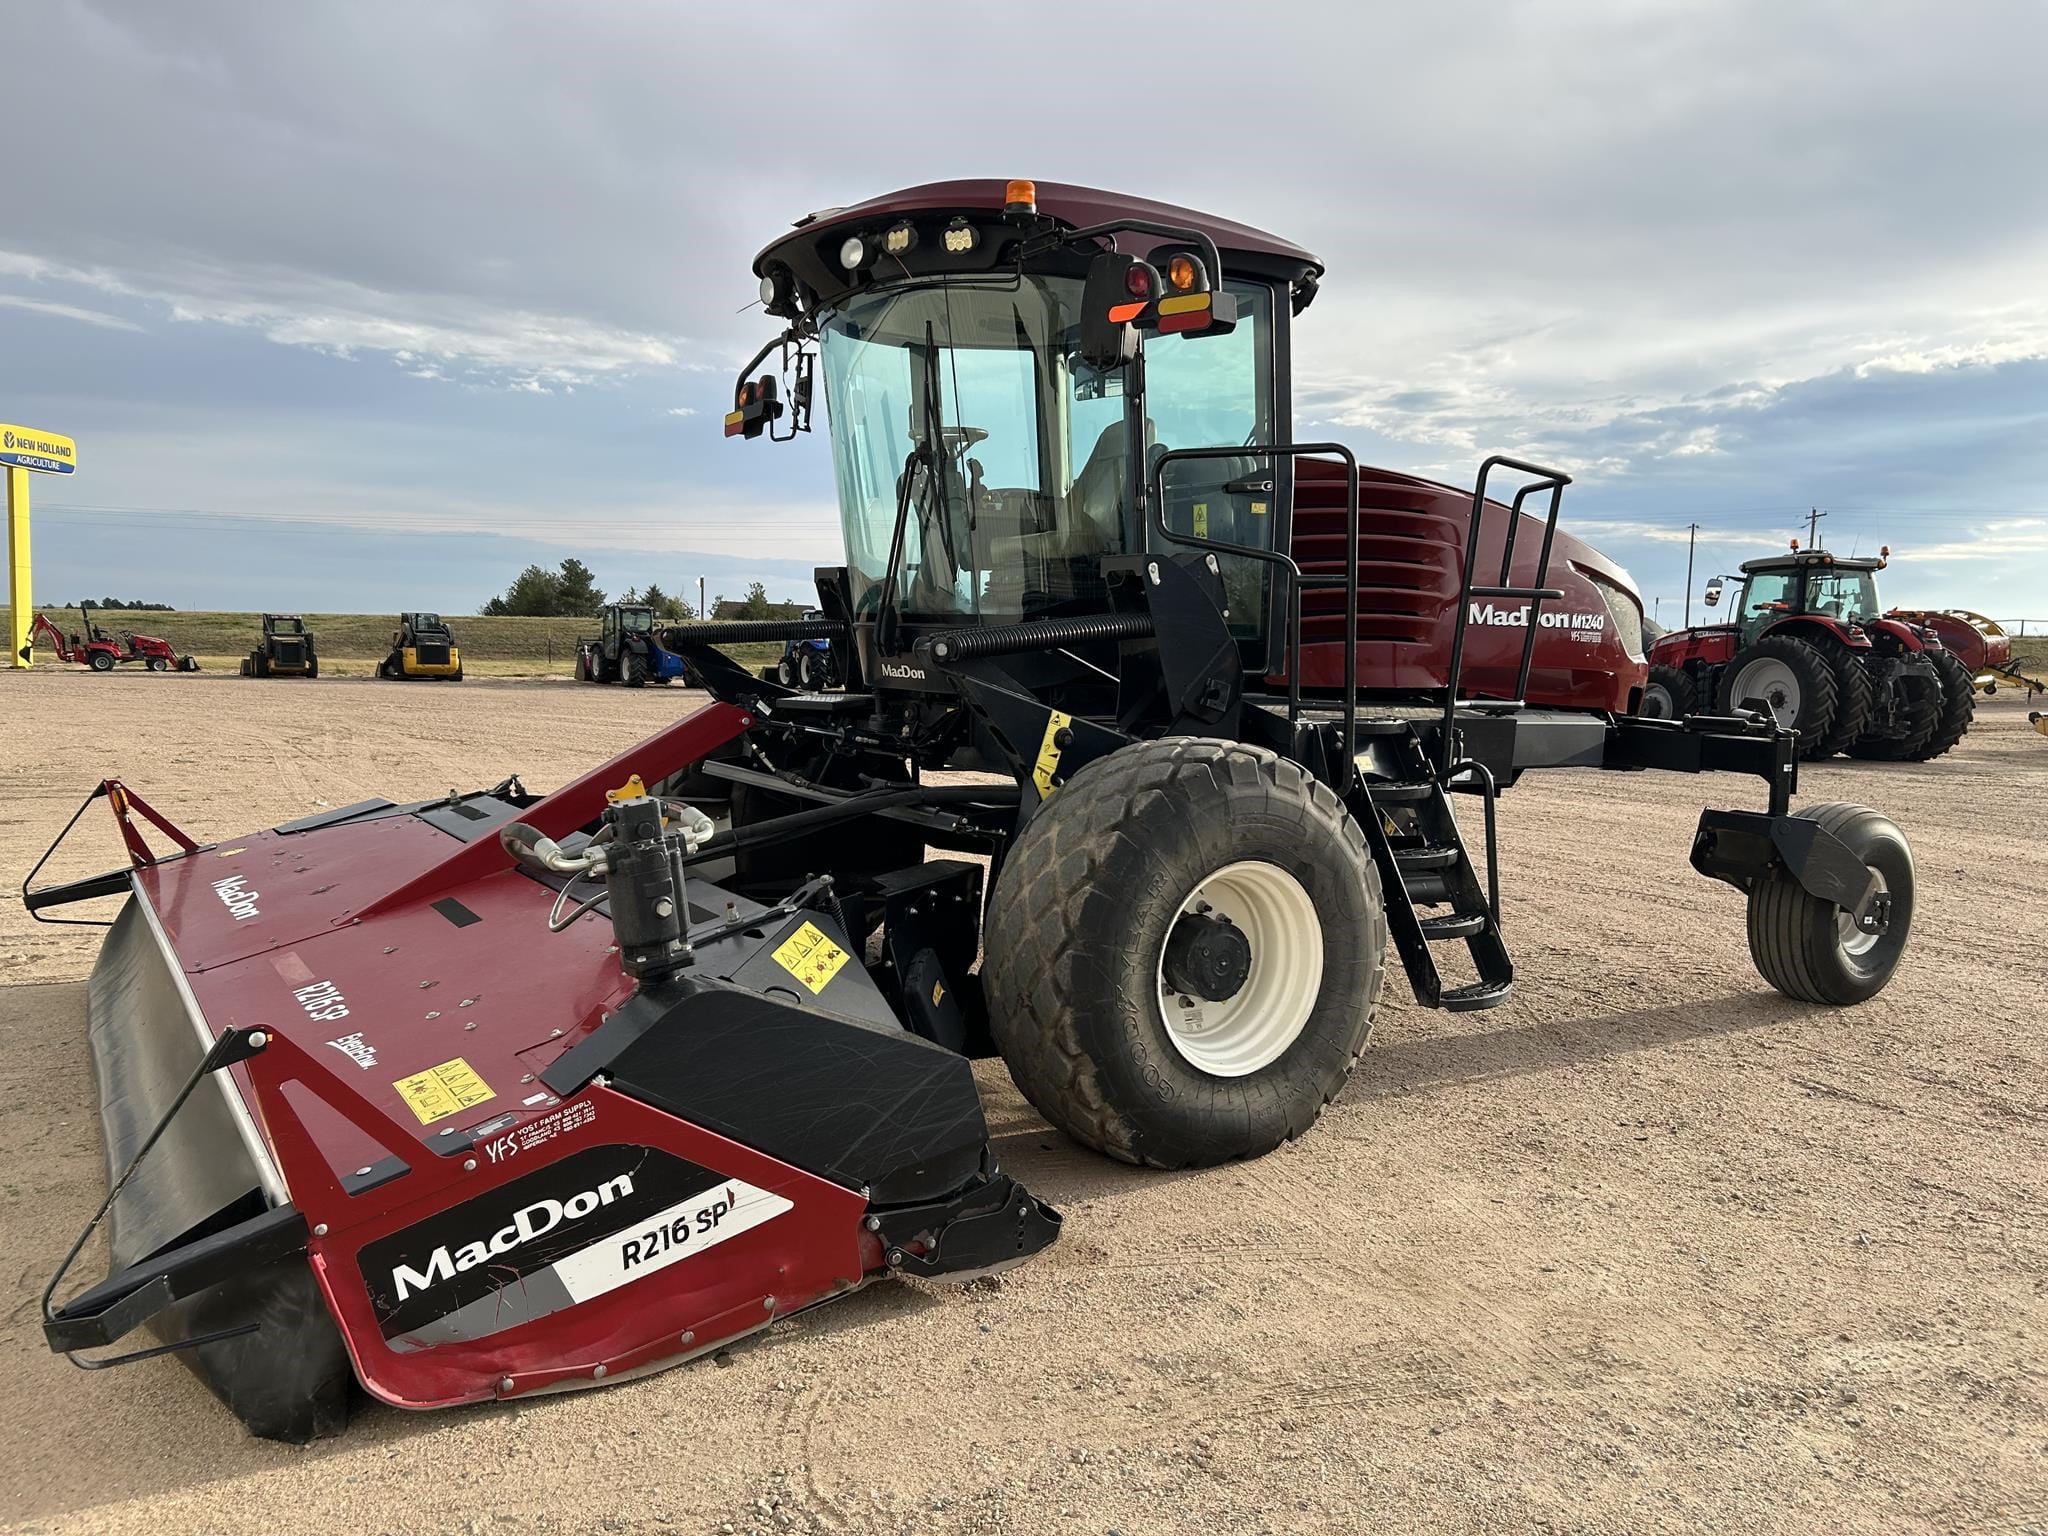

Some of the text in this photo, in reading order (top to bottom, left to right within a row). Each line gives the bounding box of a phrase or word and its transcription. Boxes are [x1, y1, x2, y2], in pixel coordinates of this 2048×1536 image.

[16, 437, 72, 457] NEW HOLLAND
[16, 455, 60, 470] AGRICULTURE
[1571, 613, 1605, 630] M1240
[881, 663, 926, 680] MacDon
[211, 874, 260, 921] MacDon
[292, 979, 350, 1022] R216 SP
[517, 1121, 538, 1136] YOST
[540, 1111, 562, 1128] FARM
[563, 1100, 592, 1117] SUPPLY
[485, 1131, 519, 1164] YFS
[392, 1174, 635, 1302] MacDon
[621, 1200, 729, 1271] R216 SP
